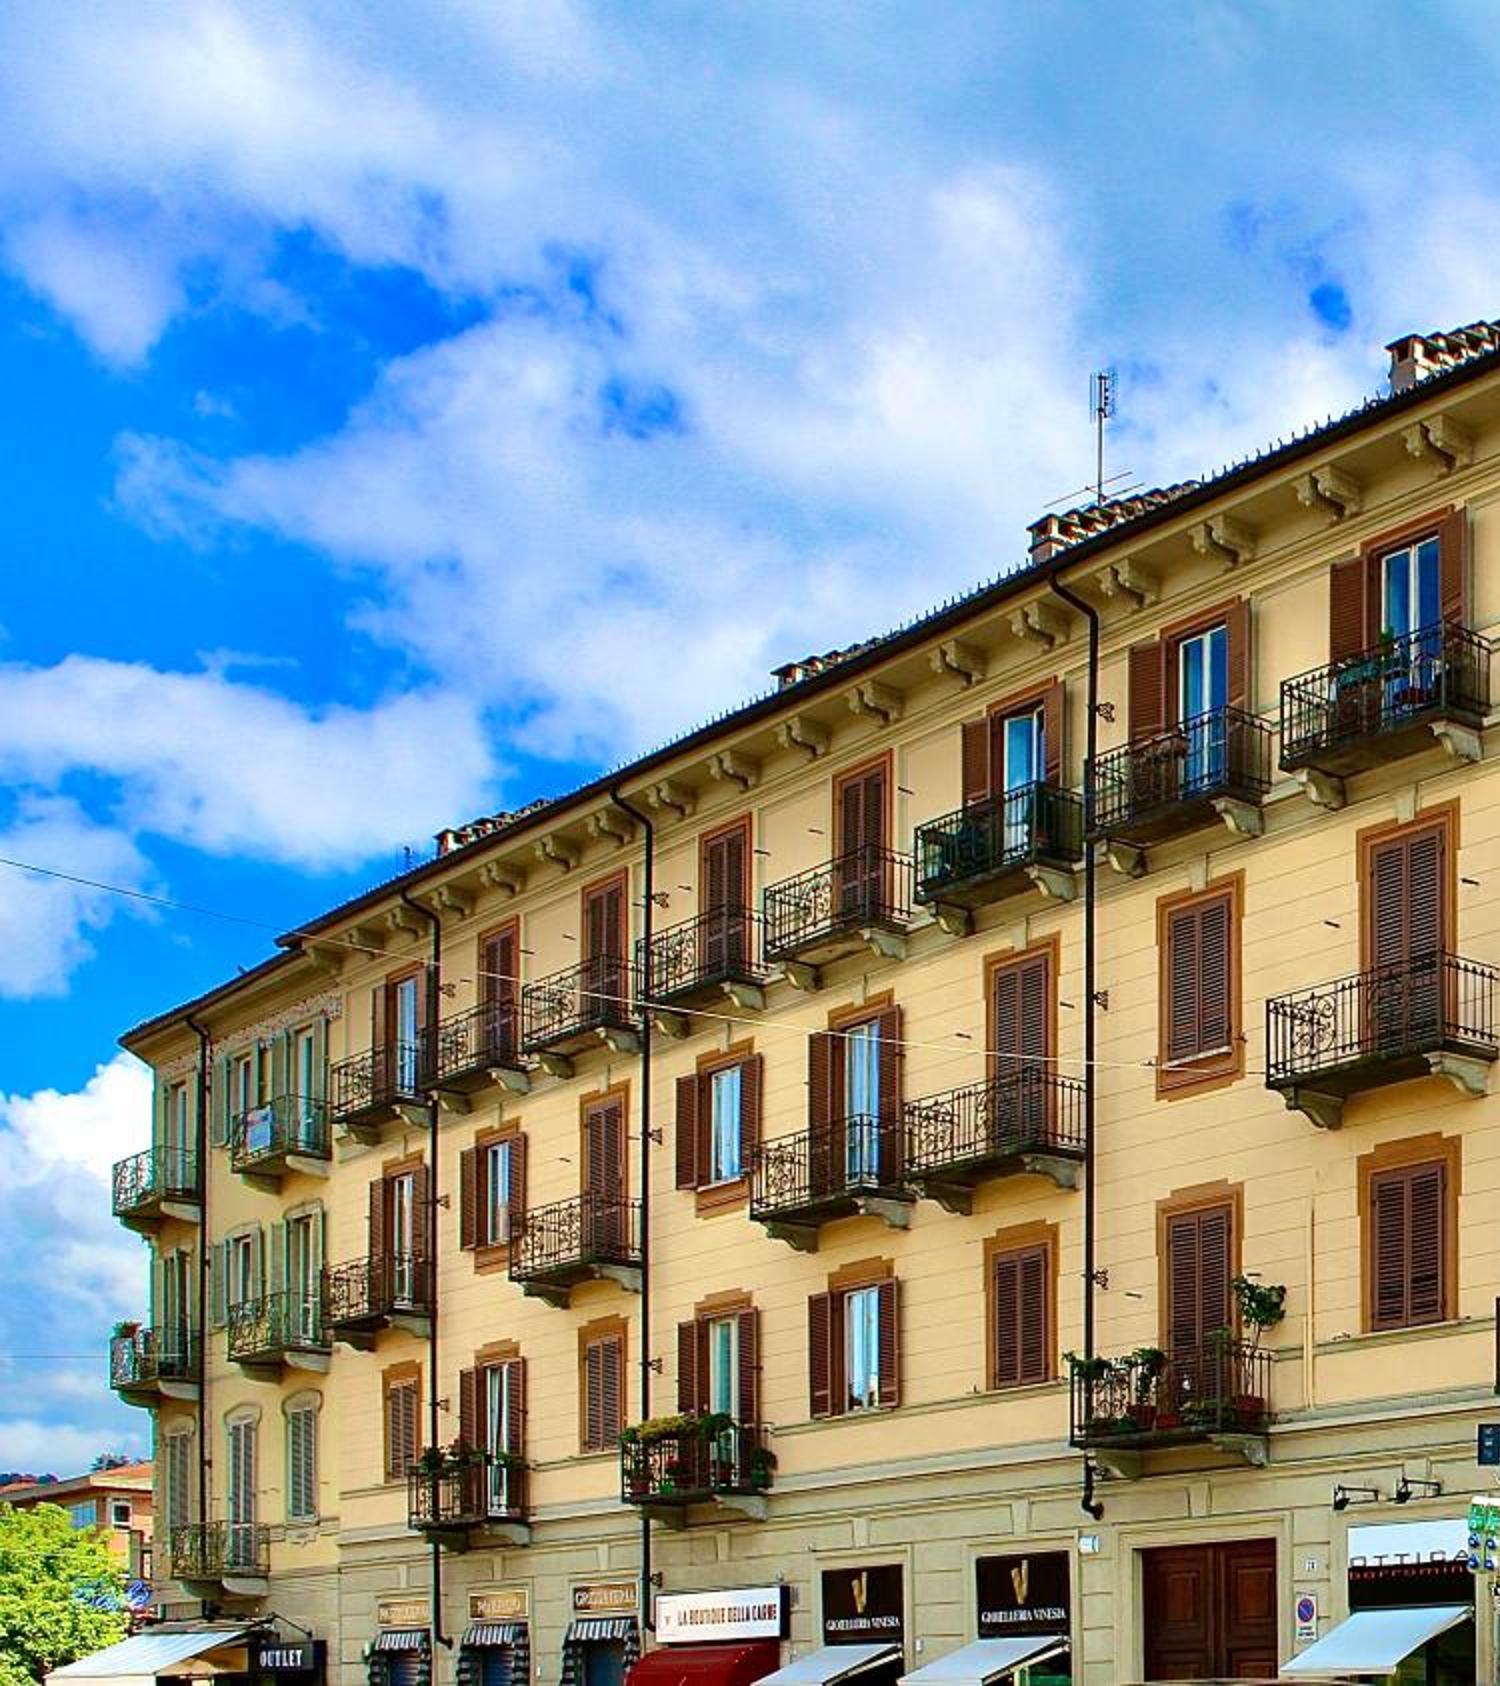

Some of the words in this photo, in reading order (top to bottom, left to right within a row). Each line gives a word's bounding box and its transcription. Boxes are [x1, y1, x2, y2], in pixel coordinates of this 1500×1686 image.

[1350, 1549, 1469, 1569] OTTICA
[678, 1609, 688, 1626] LA
[727, 1605, 751, 1624] DELLA
[260, 1648, 304, 1668] OUTLET
